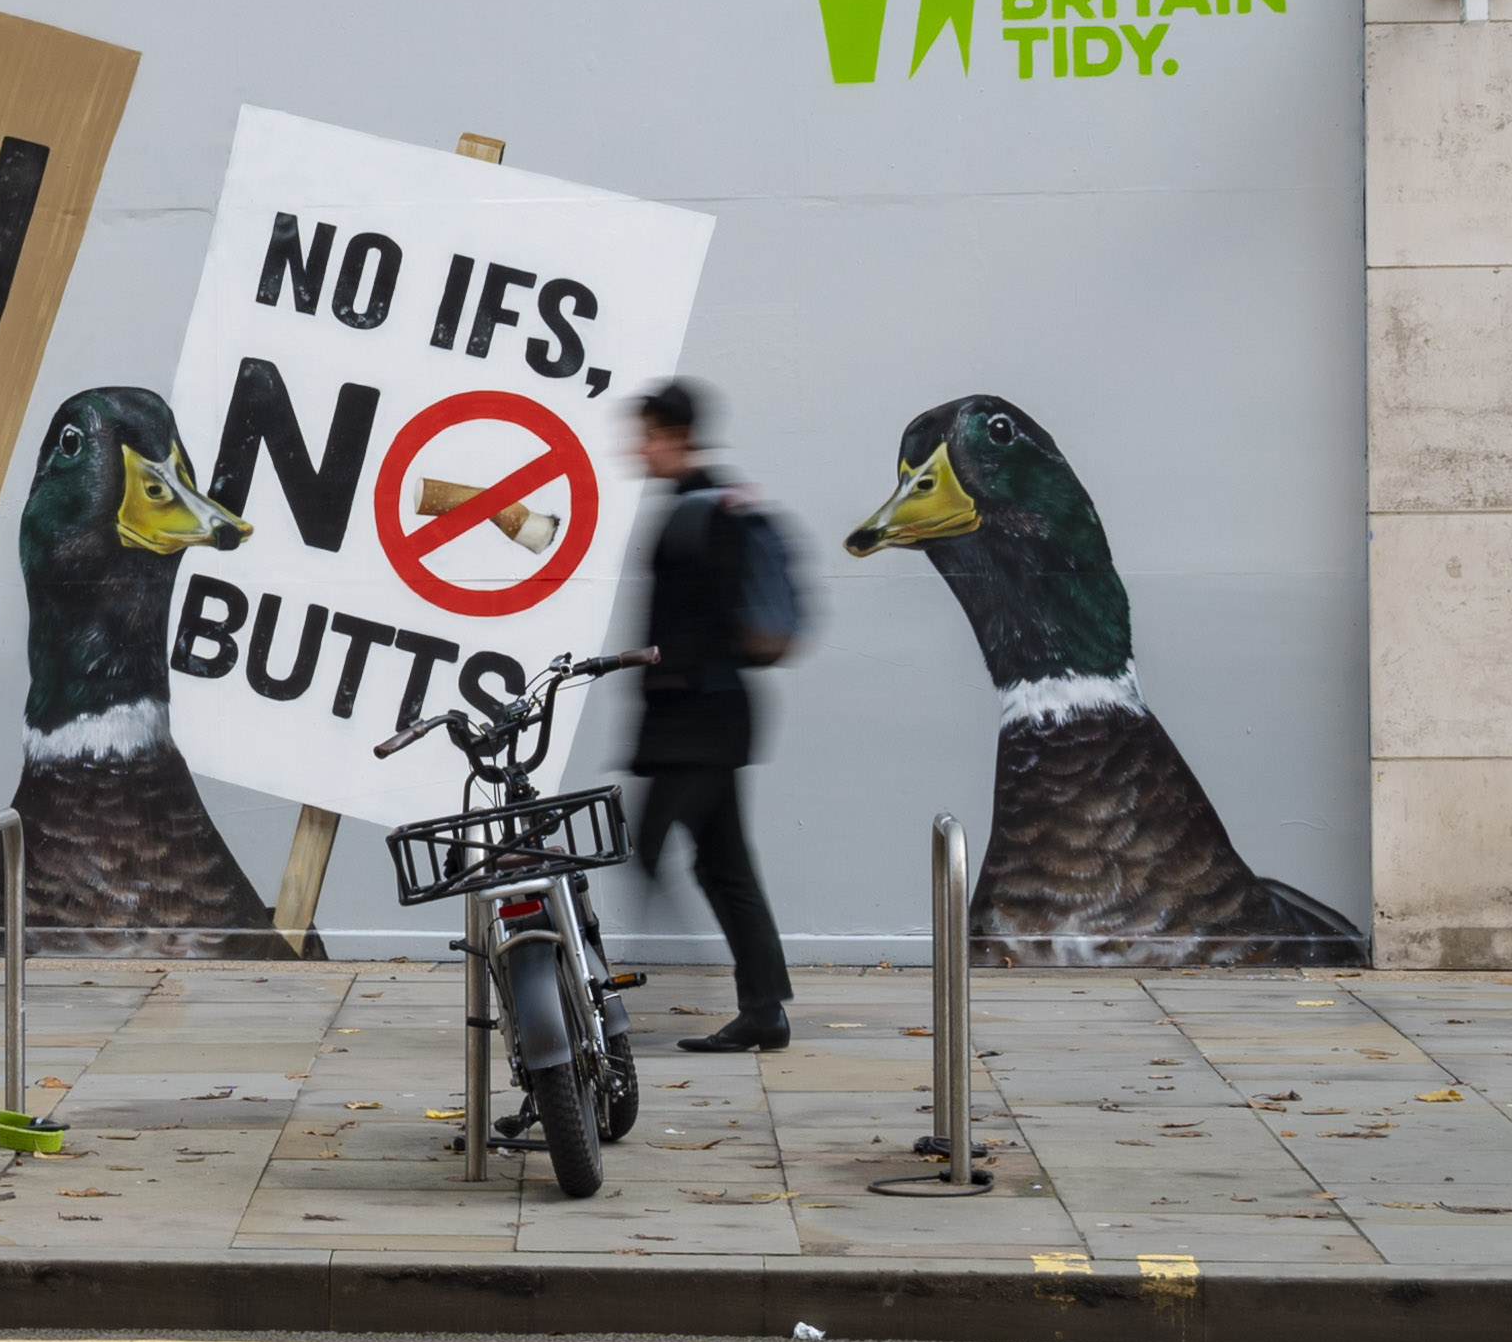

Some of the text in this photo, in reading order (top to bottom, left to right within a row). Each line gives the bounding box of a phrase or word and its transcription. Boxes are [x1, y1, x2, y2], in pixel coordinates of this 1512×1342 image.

[1002, 23, 1179, 79] TIDY.
[256, 212, 612, 399] NO IFS,
[170, 573, 527, 757] BUTTS
